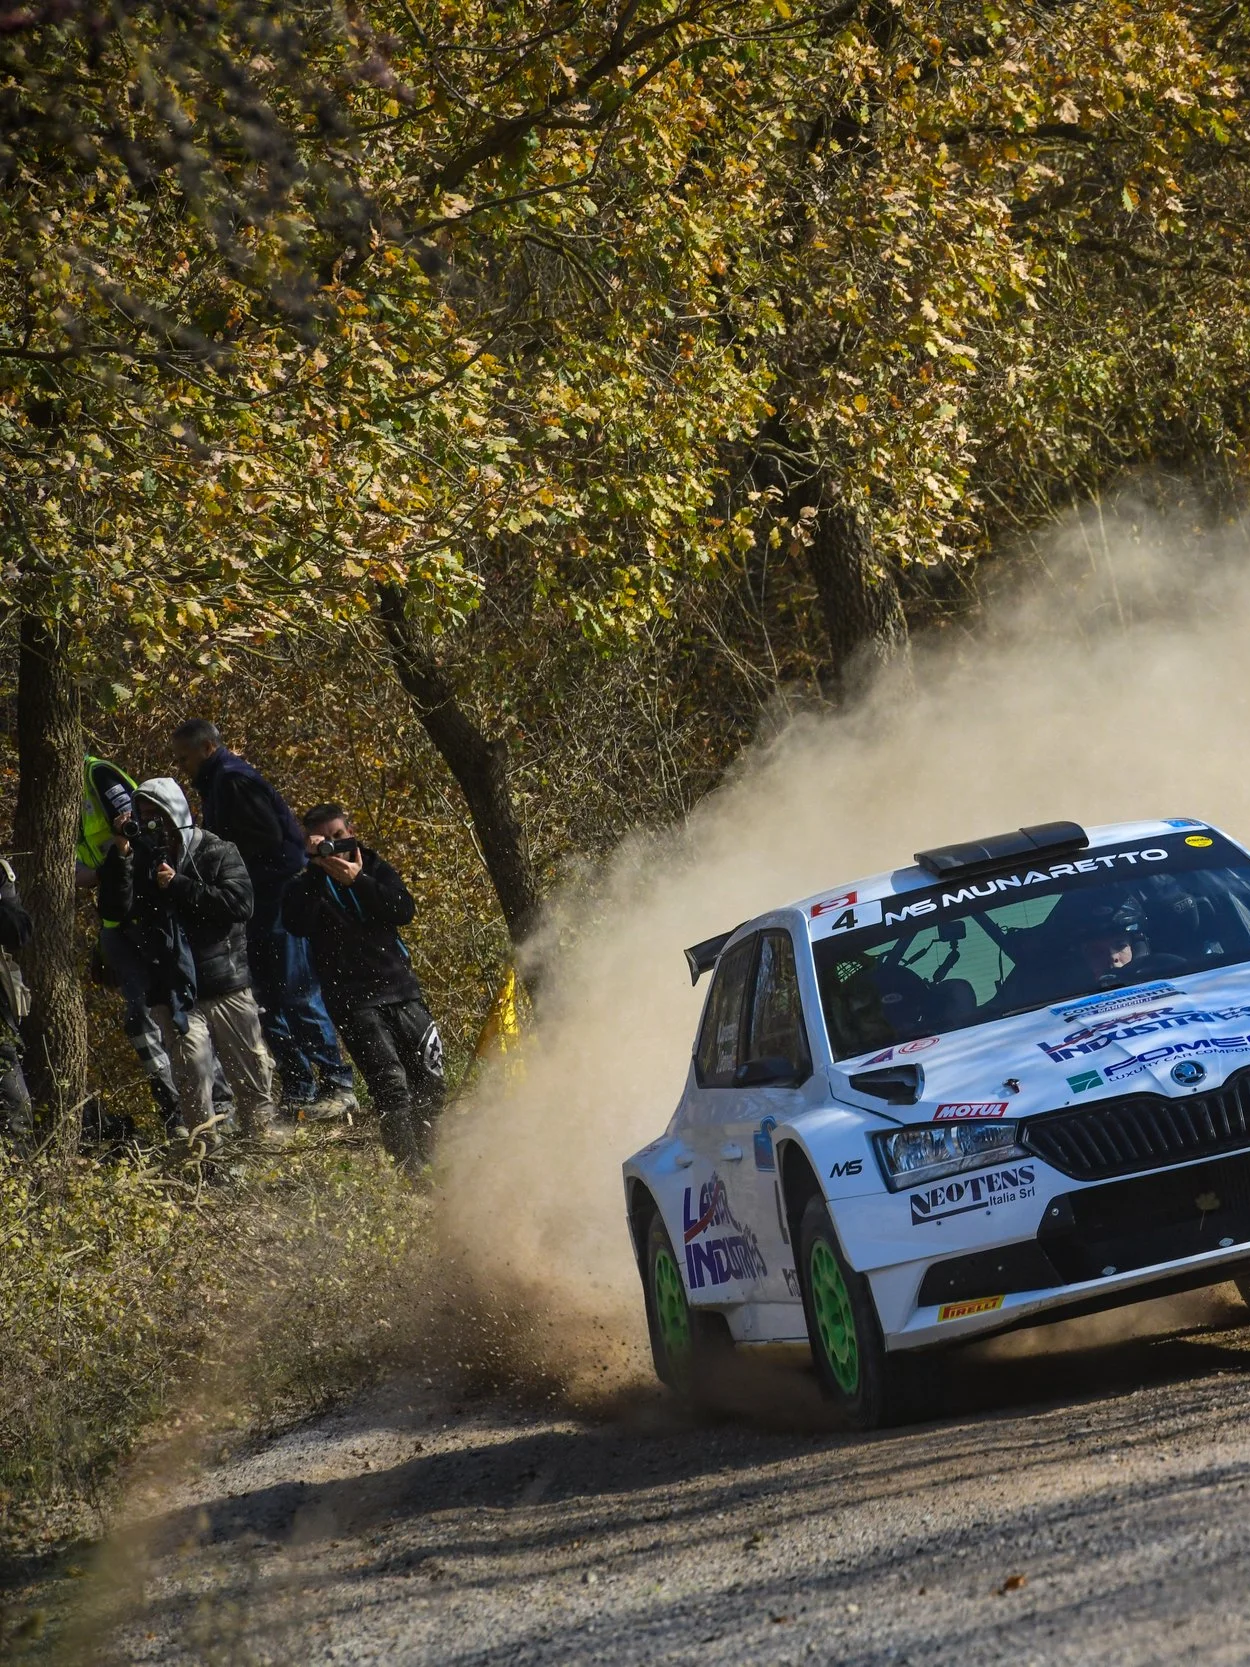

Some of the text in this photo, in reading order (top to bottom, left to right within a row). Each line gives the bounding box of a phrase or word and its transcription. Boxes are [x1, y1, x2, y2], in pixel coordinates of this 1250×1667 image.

[885, 848, 1169, 926] MS MUNARETTO
[832, 908, 858, 930] 4
[1062, 986, 1175, 1017] CONCORRENTE
[1109, 1060, 1158, 1082] LUXURY
[1164, 1052, 1192, 1062] CAR
[936, 1104, 1002, 1119] MOTUL
[829, 1159, 863, 1178] MS
[910, 1165, 1035, 1215] NEOTENS
[989, 1187, 1035, 1206] Italia Srl
[942, 1296, 1000, 1319] PIRELLI
